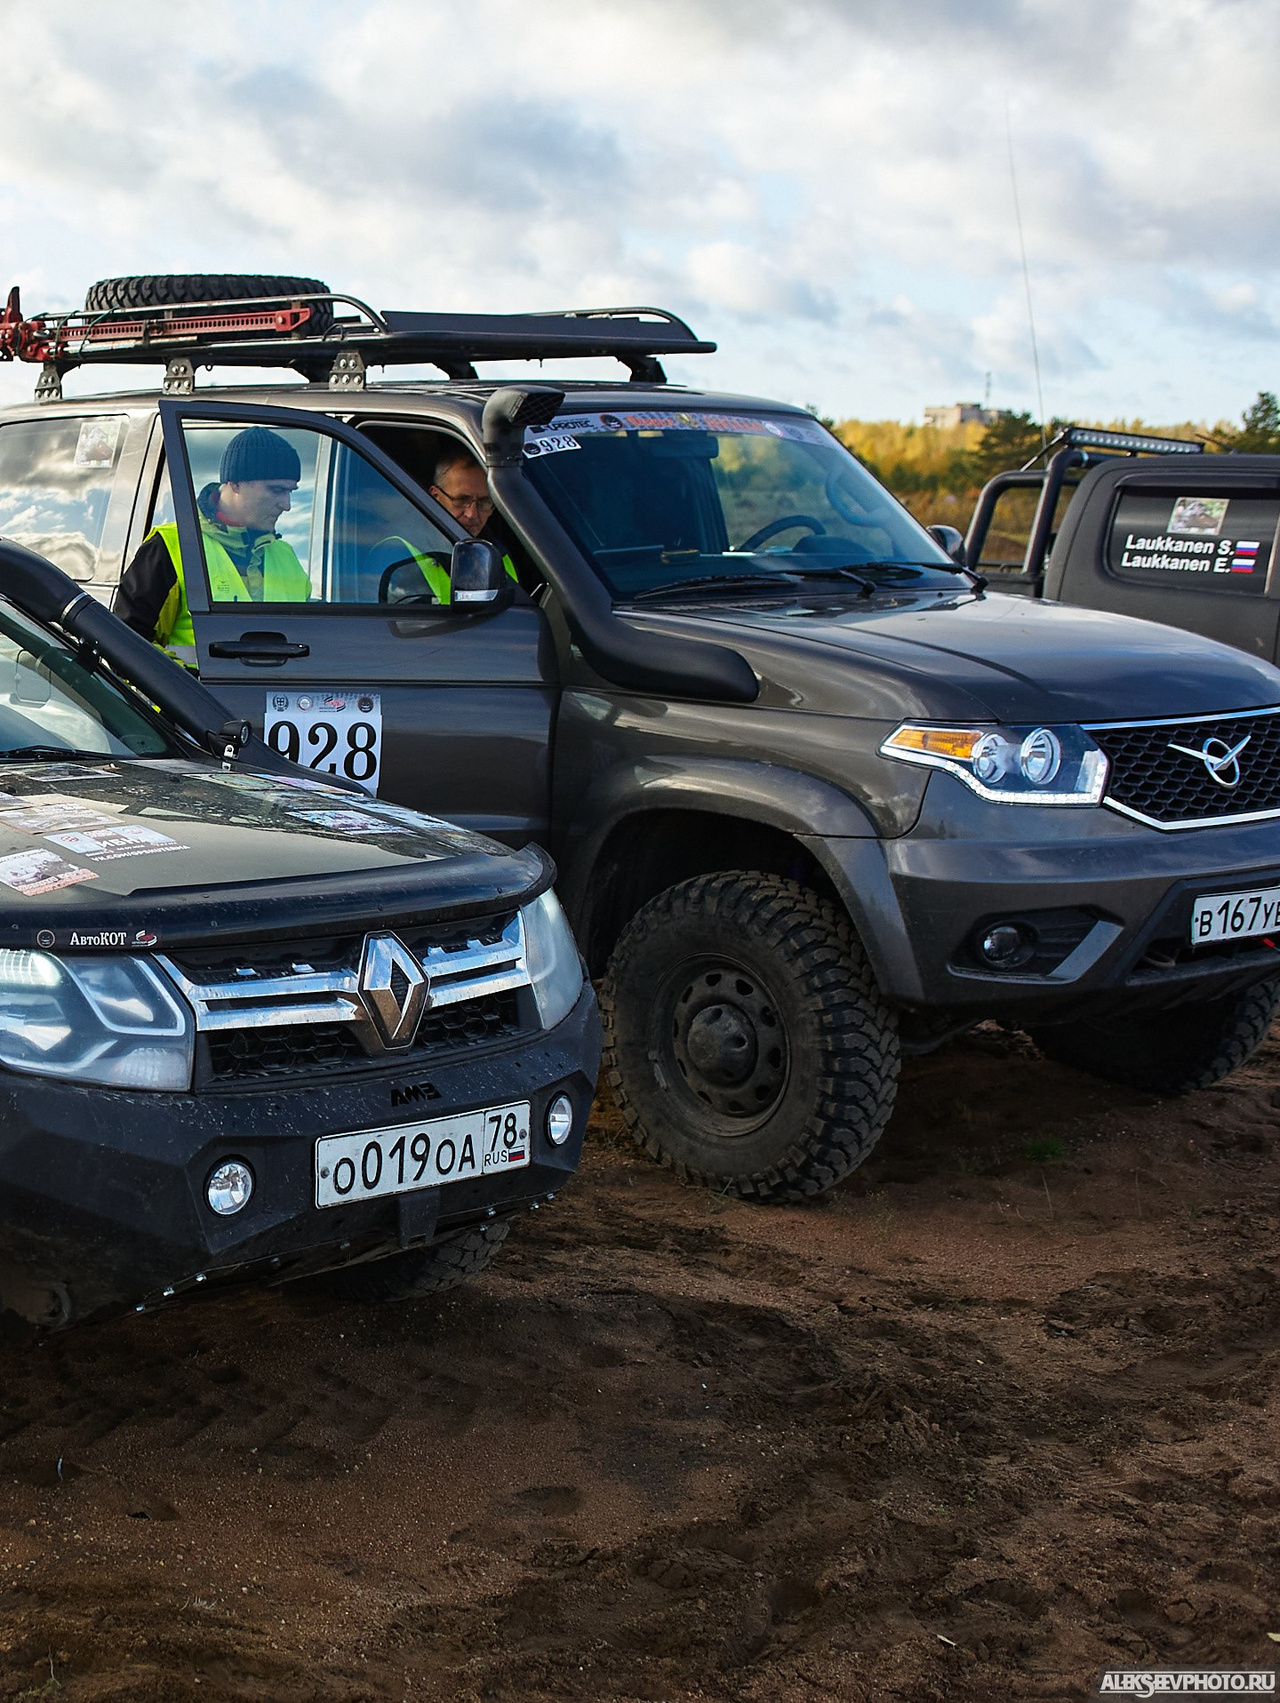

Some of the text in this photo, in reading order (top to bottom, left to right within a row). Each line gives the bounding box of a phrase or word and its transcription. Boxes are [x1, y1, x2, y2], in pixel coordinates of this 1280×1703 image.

[539, 435, 577, 453] 928
[1125, 534, 1235, 556] Laukkanen S.
[1121, 551, 1231, 573] Laukkanen E.
[268, 720, 378, 781] 928
[487, 1112, 518, 1151] 78
[483, 1150, 508, 1168] RUS
